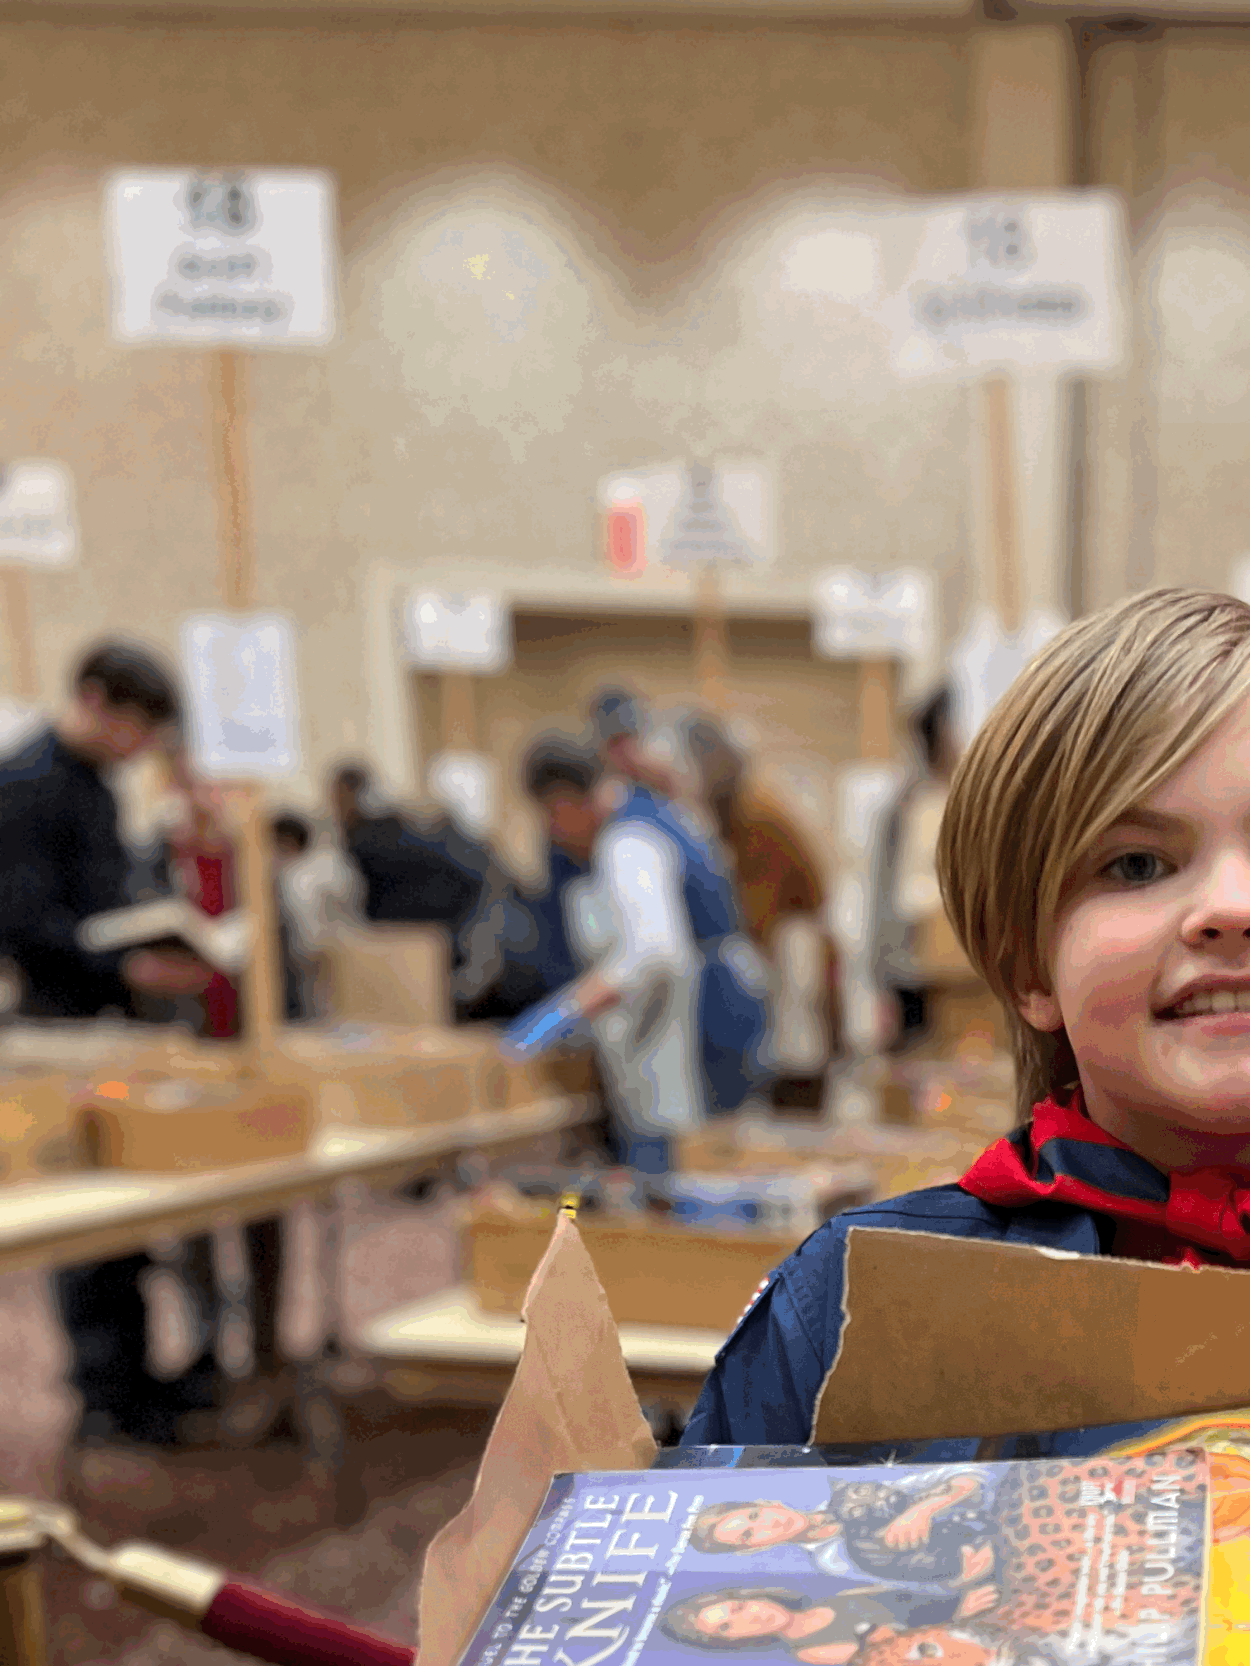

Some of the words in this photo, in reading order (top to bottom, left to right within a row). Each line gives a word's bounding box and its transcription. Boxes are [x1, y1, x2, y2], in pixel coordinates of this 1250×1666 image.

[492, 1622, 512, 1640] TO
[506, 1596, 527, 1618] THE
[520, 1550, 549, 1594] GOLDEN
[533, 1493, 620, 1613] SUBTLE
[1140, 1474, 1181, 1596] PULLMAN
